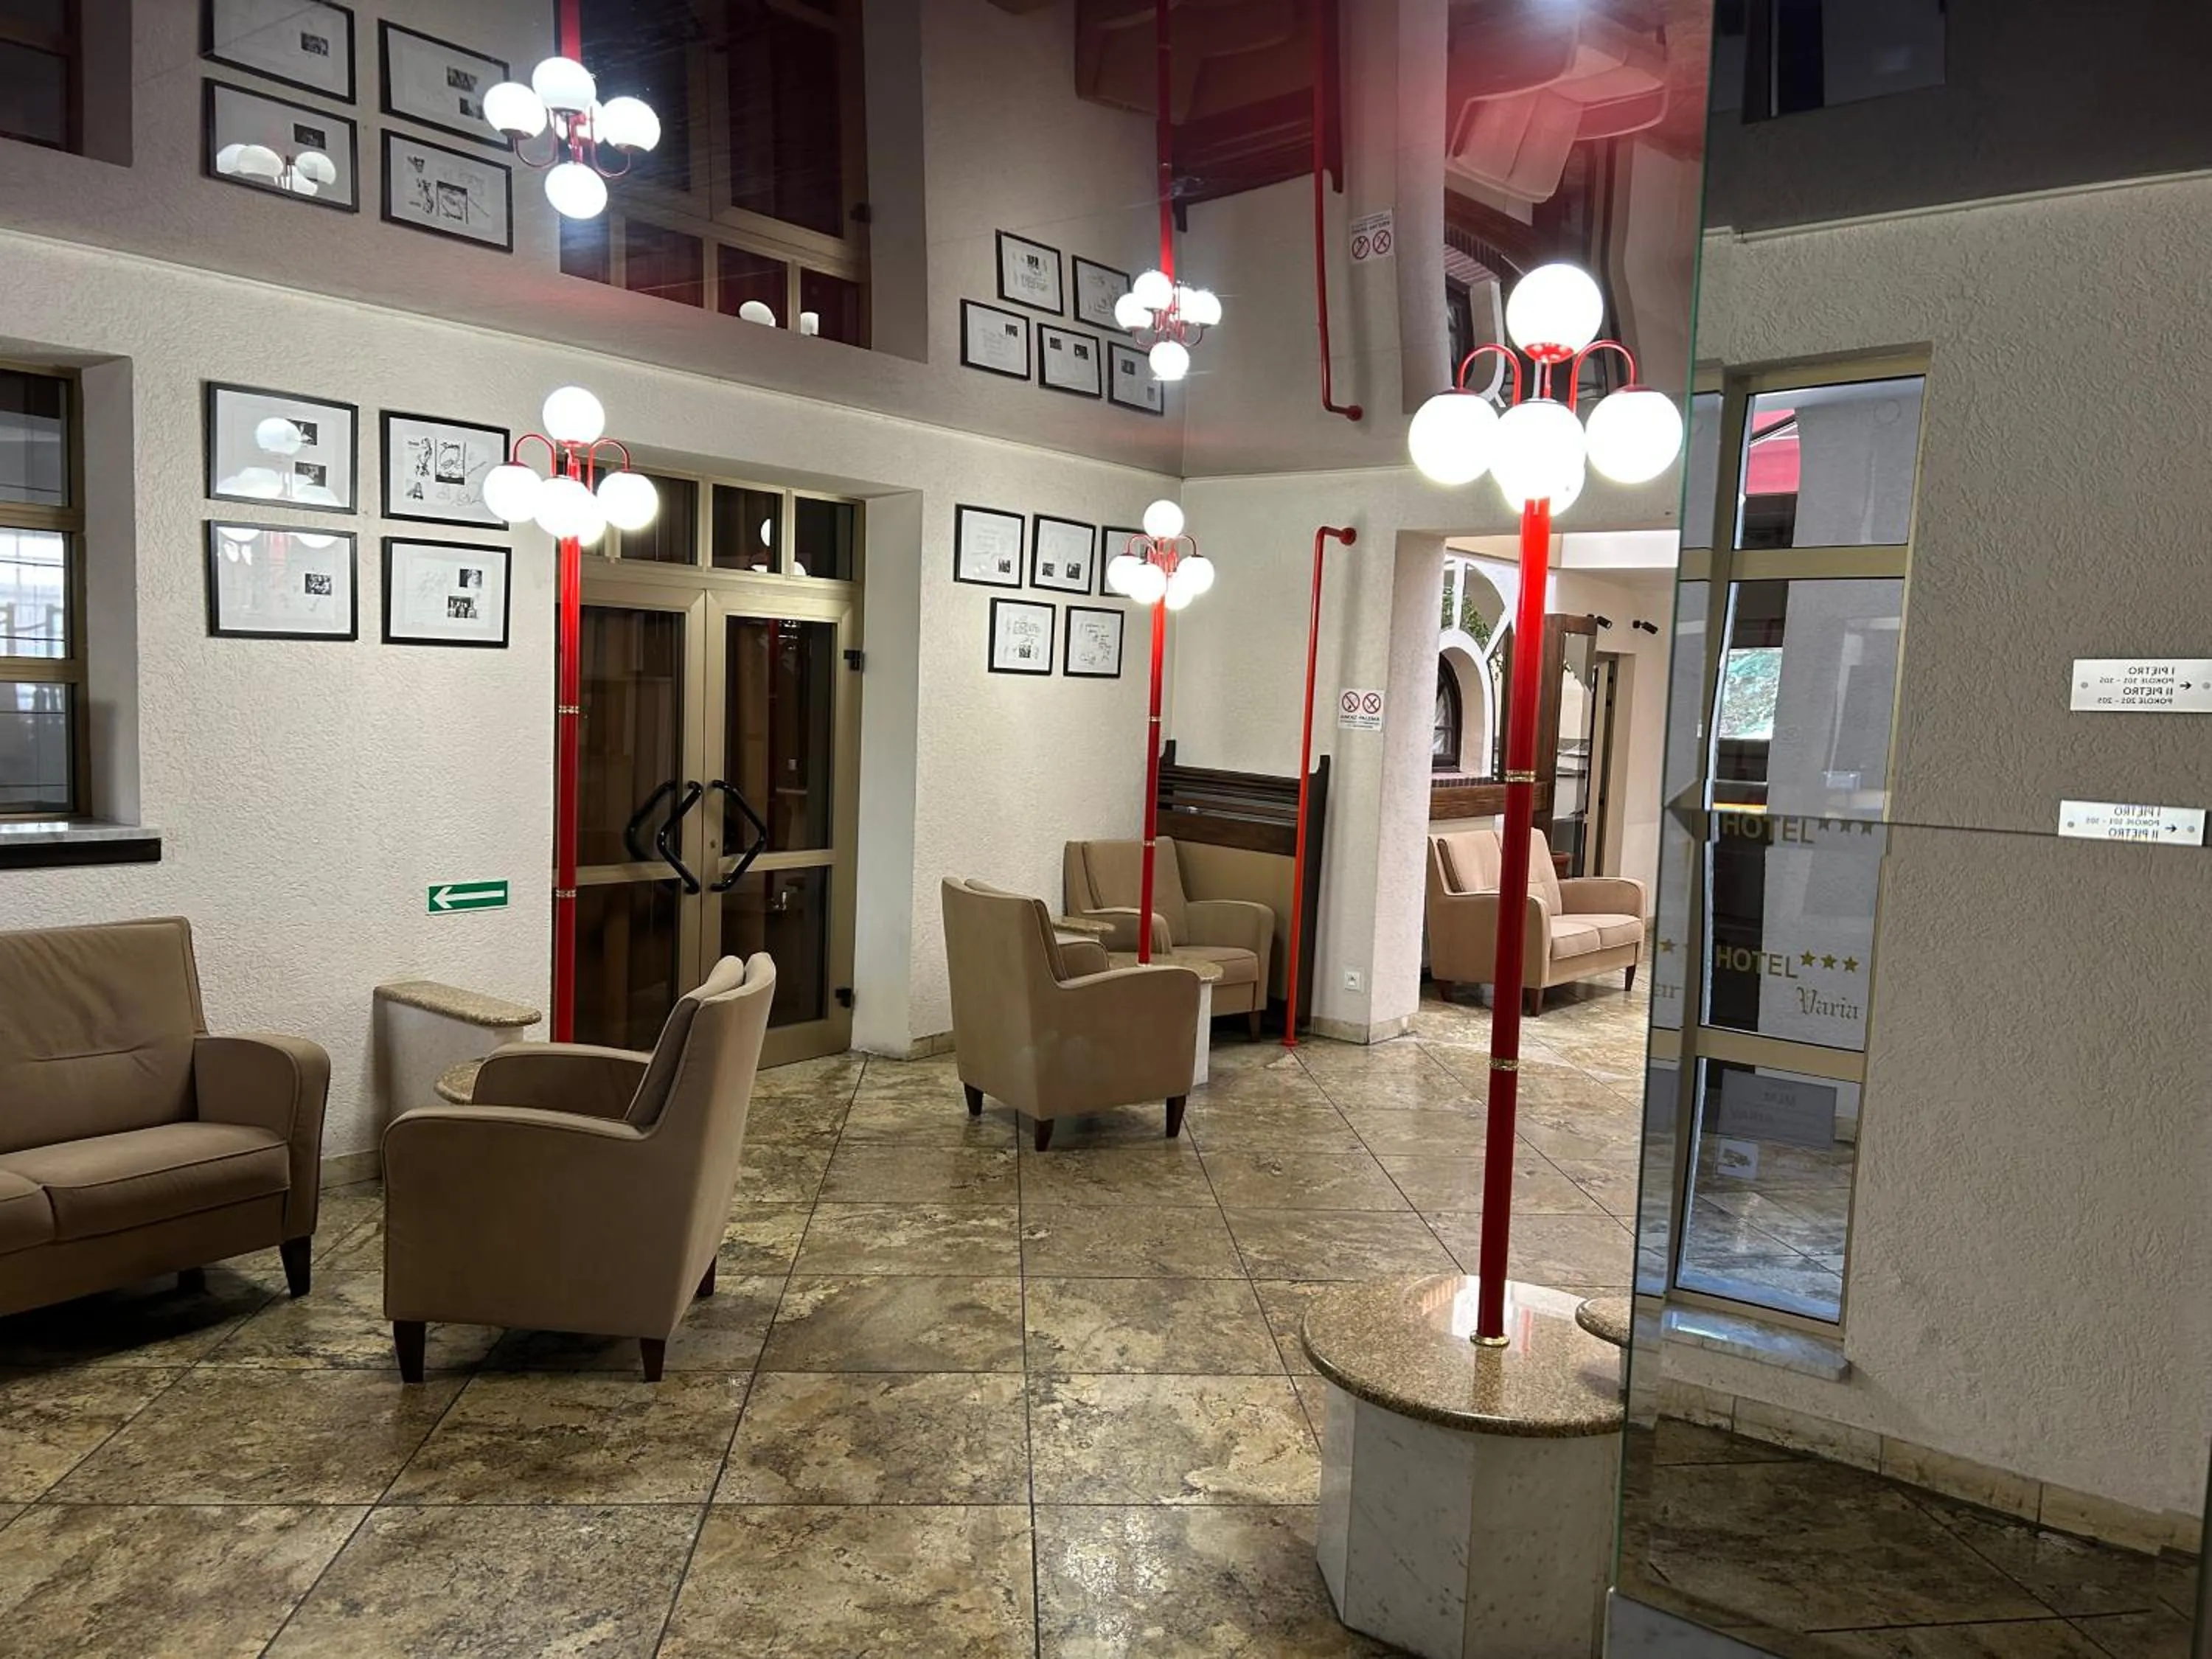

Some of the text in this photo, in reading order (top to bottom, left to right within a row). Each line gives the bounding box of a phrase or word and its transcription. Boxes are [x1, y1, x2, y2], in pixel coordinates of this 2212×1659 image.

[1722, 813, 1815, 844] HOTEL
[1716, 945, 1798, 979] HOTEL
[1797, 986, 1859, 1020] Varia
